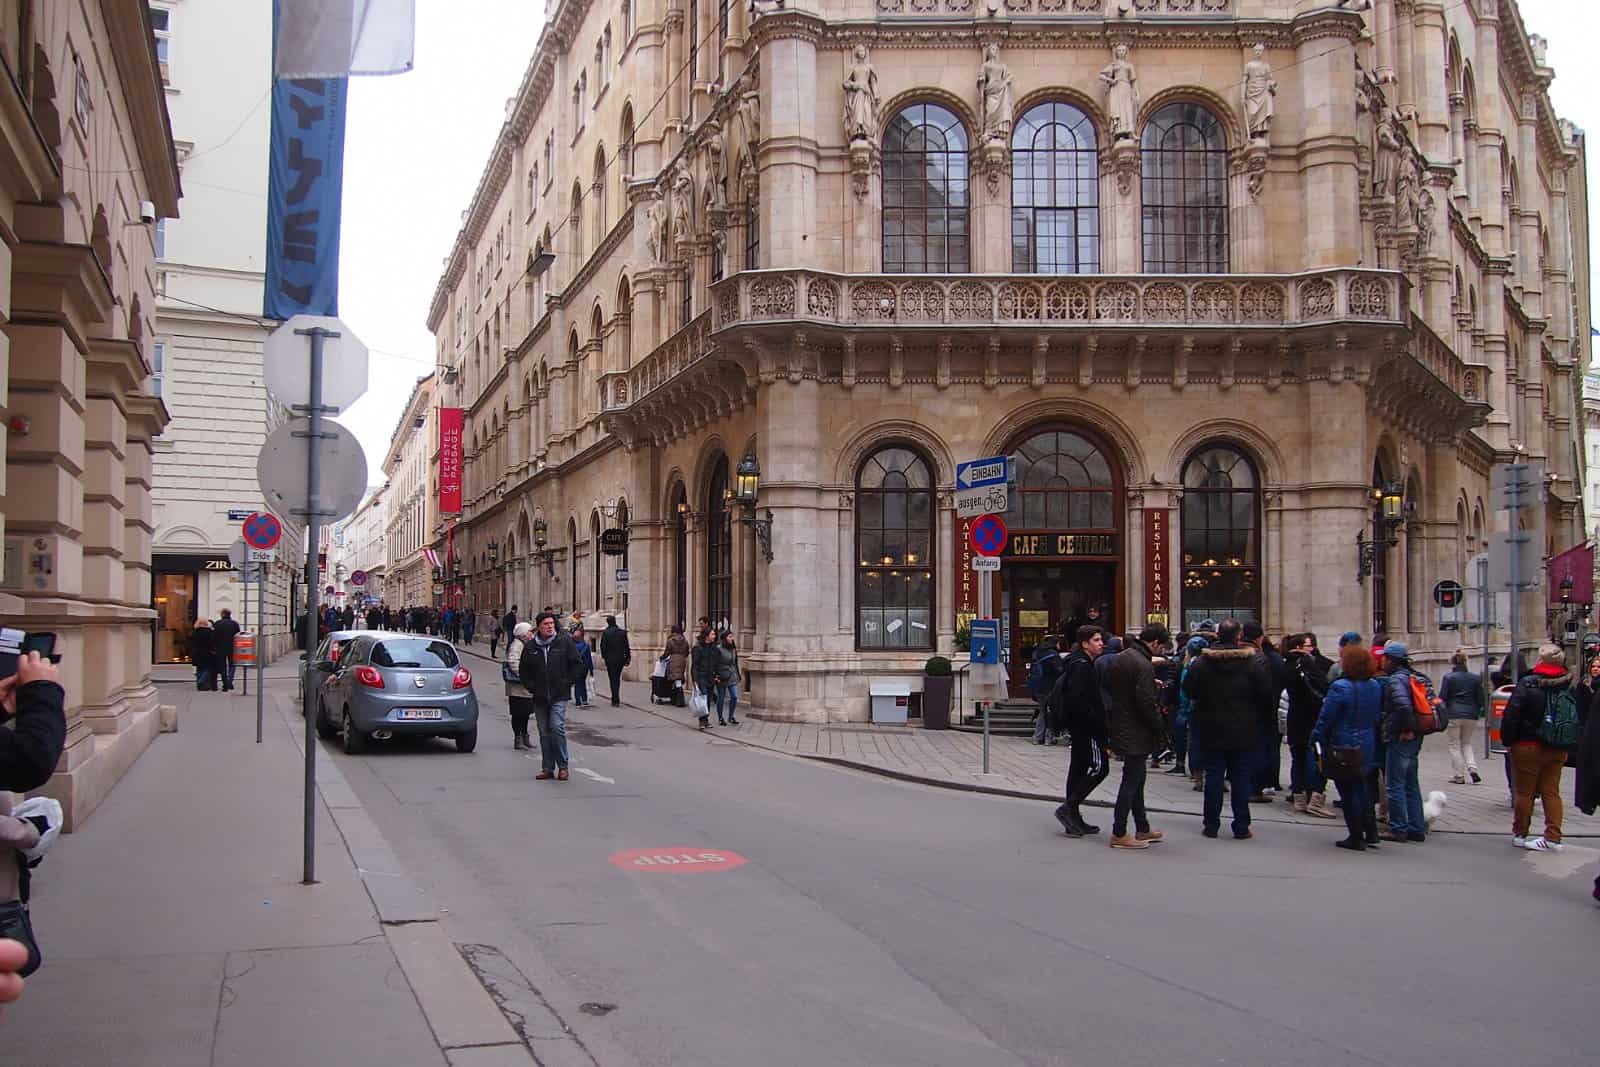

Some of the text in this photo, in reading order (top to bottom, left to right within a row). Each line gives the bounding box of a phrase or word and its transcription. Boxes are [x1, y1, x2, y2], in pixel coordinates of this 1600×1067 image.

[450, 428, 458, 478] PASSAGE
[971, 463, 1002, 481] EINBAHN
[959, 496, 984, 510] ausgen.
[1057, 535, 1113, 555] CENTRAL
[252, 551, 271, 561] Ende
[962, 516, 970, 611] ATISSERIE
[975, 559, 998, 569] Anfang
[1153, 511, 1161, 611] RESTAURANT
[633, 853, 726, 865] STOP
